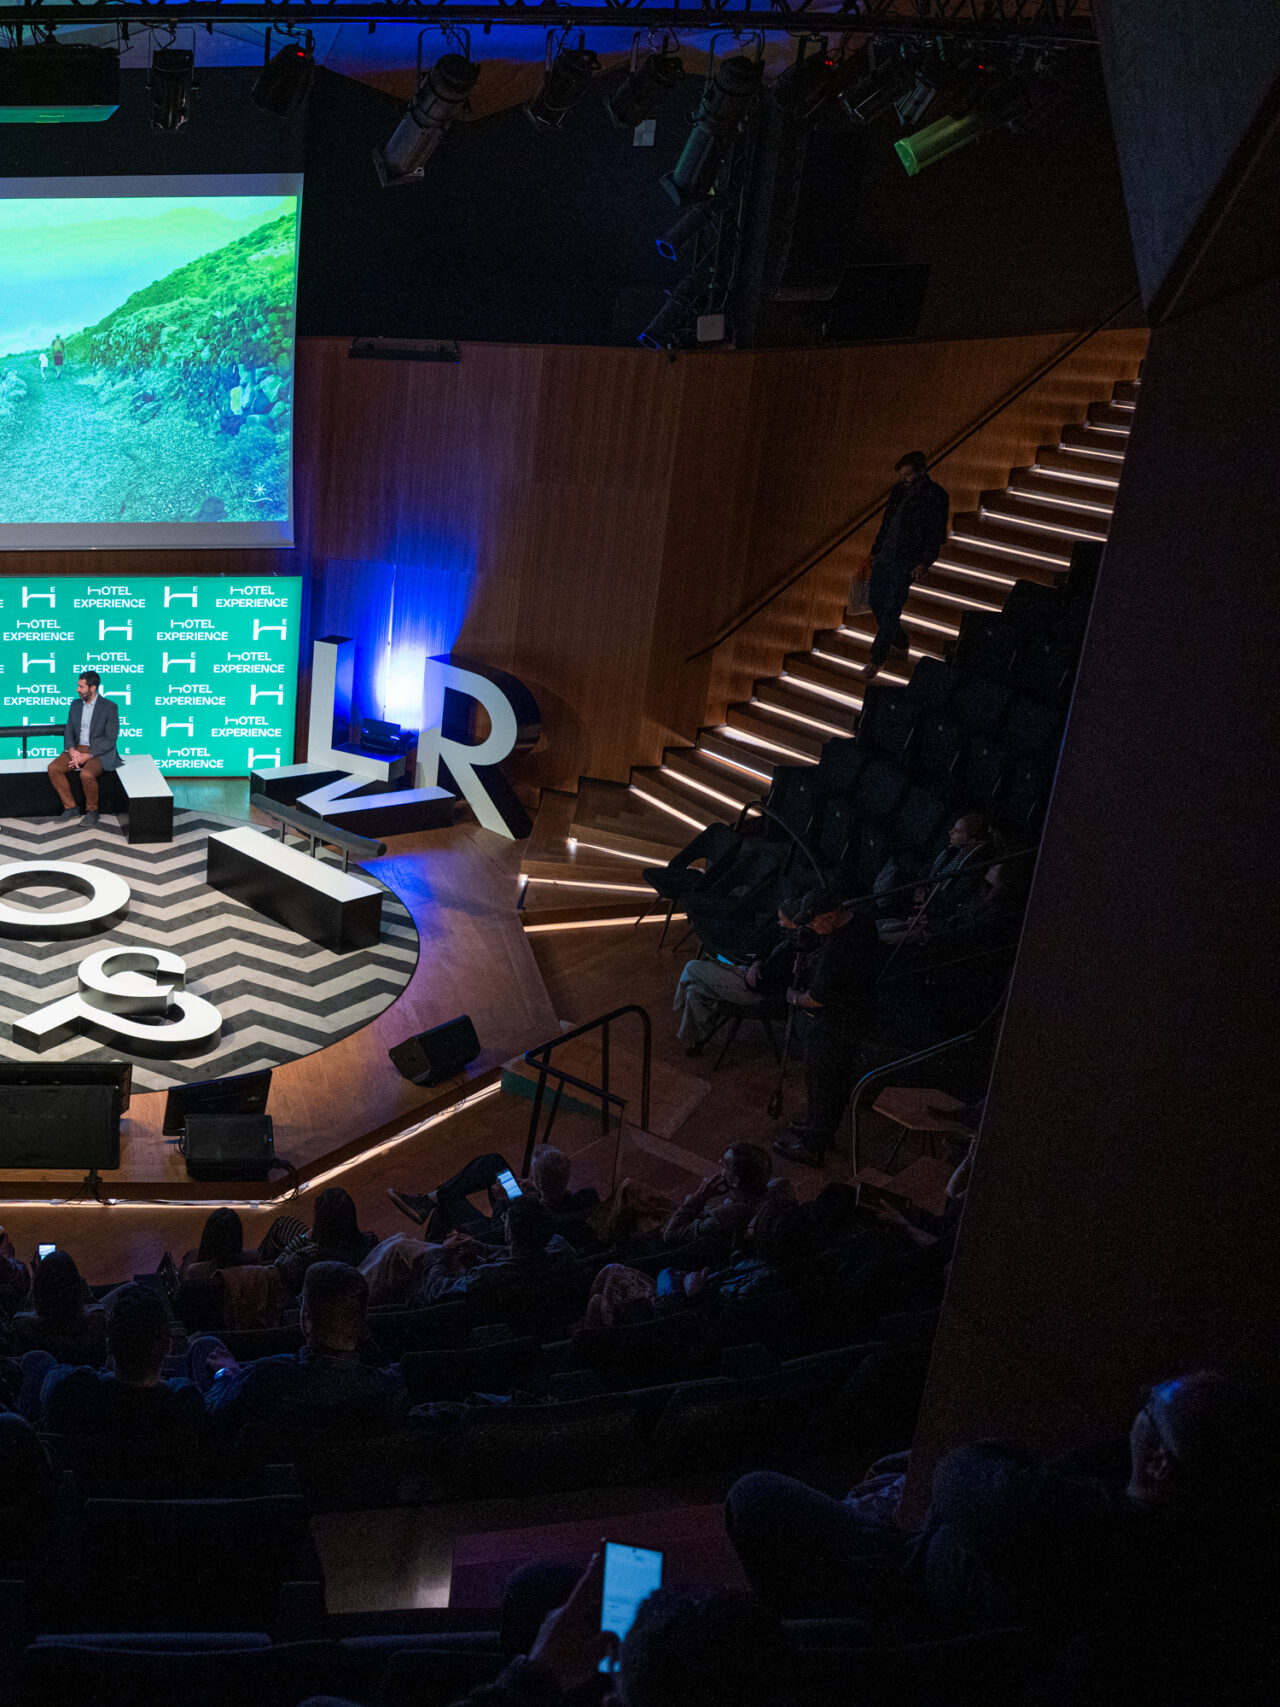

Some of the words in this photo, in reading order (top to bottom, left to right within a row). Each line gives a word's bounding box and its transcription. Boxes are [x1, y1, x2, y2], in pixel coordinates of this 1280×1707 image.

[87, 585, 133, 596] HOTEL
[229, 585, 275, 596] HOTEL
[73, 598, 146, 609] EXPERIENCE
[215, 597, 289, 608] EXPERIENCE
[16, 619, 61, 629] HOTEL
[170, 618, 215, 629] HOTEL
[2, 631, 75, 642] EXPERIENCE
[156, 631, 229, 641] EXPERIENCE
[86, 651, 131, 662] HOTEL
[227, 651, 272, 662] HOTEL
[73, 664, 145, 674] EXPERIENCE
[213, 663, 285, 674] EXPERIENCE
[16, 684, 61, 694] HOTEL
[168, 684, 213, 694] HOTEL
[3, 696, 74, 706] EXPERIENCE
[154, 696, 226, 706] EXPERIENCE
[224, 715, 269, 726] HOTEL
[210, 727, 282, 738] EXPERIENCE
[167, 747, 211, 757] HOTEL
[153, 759, 225, 769] EXPERIENCE
